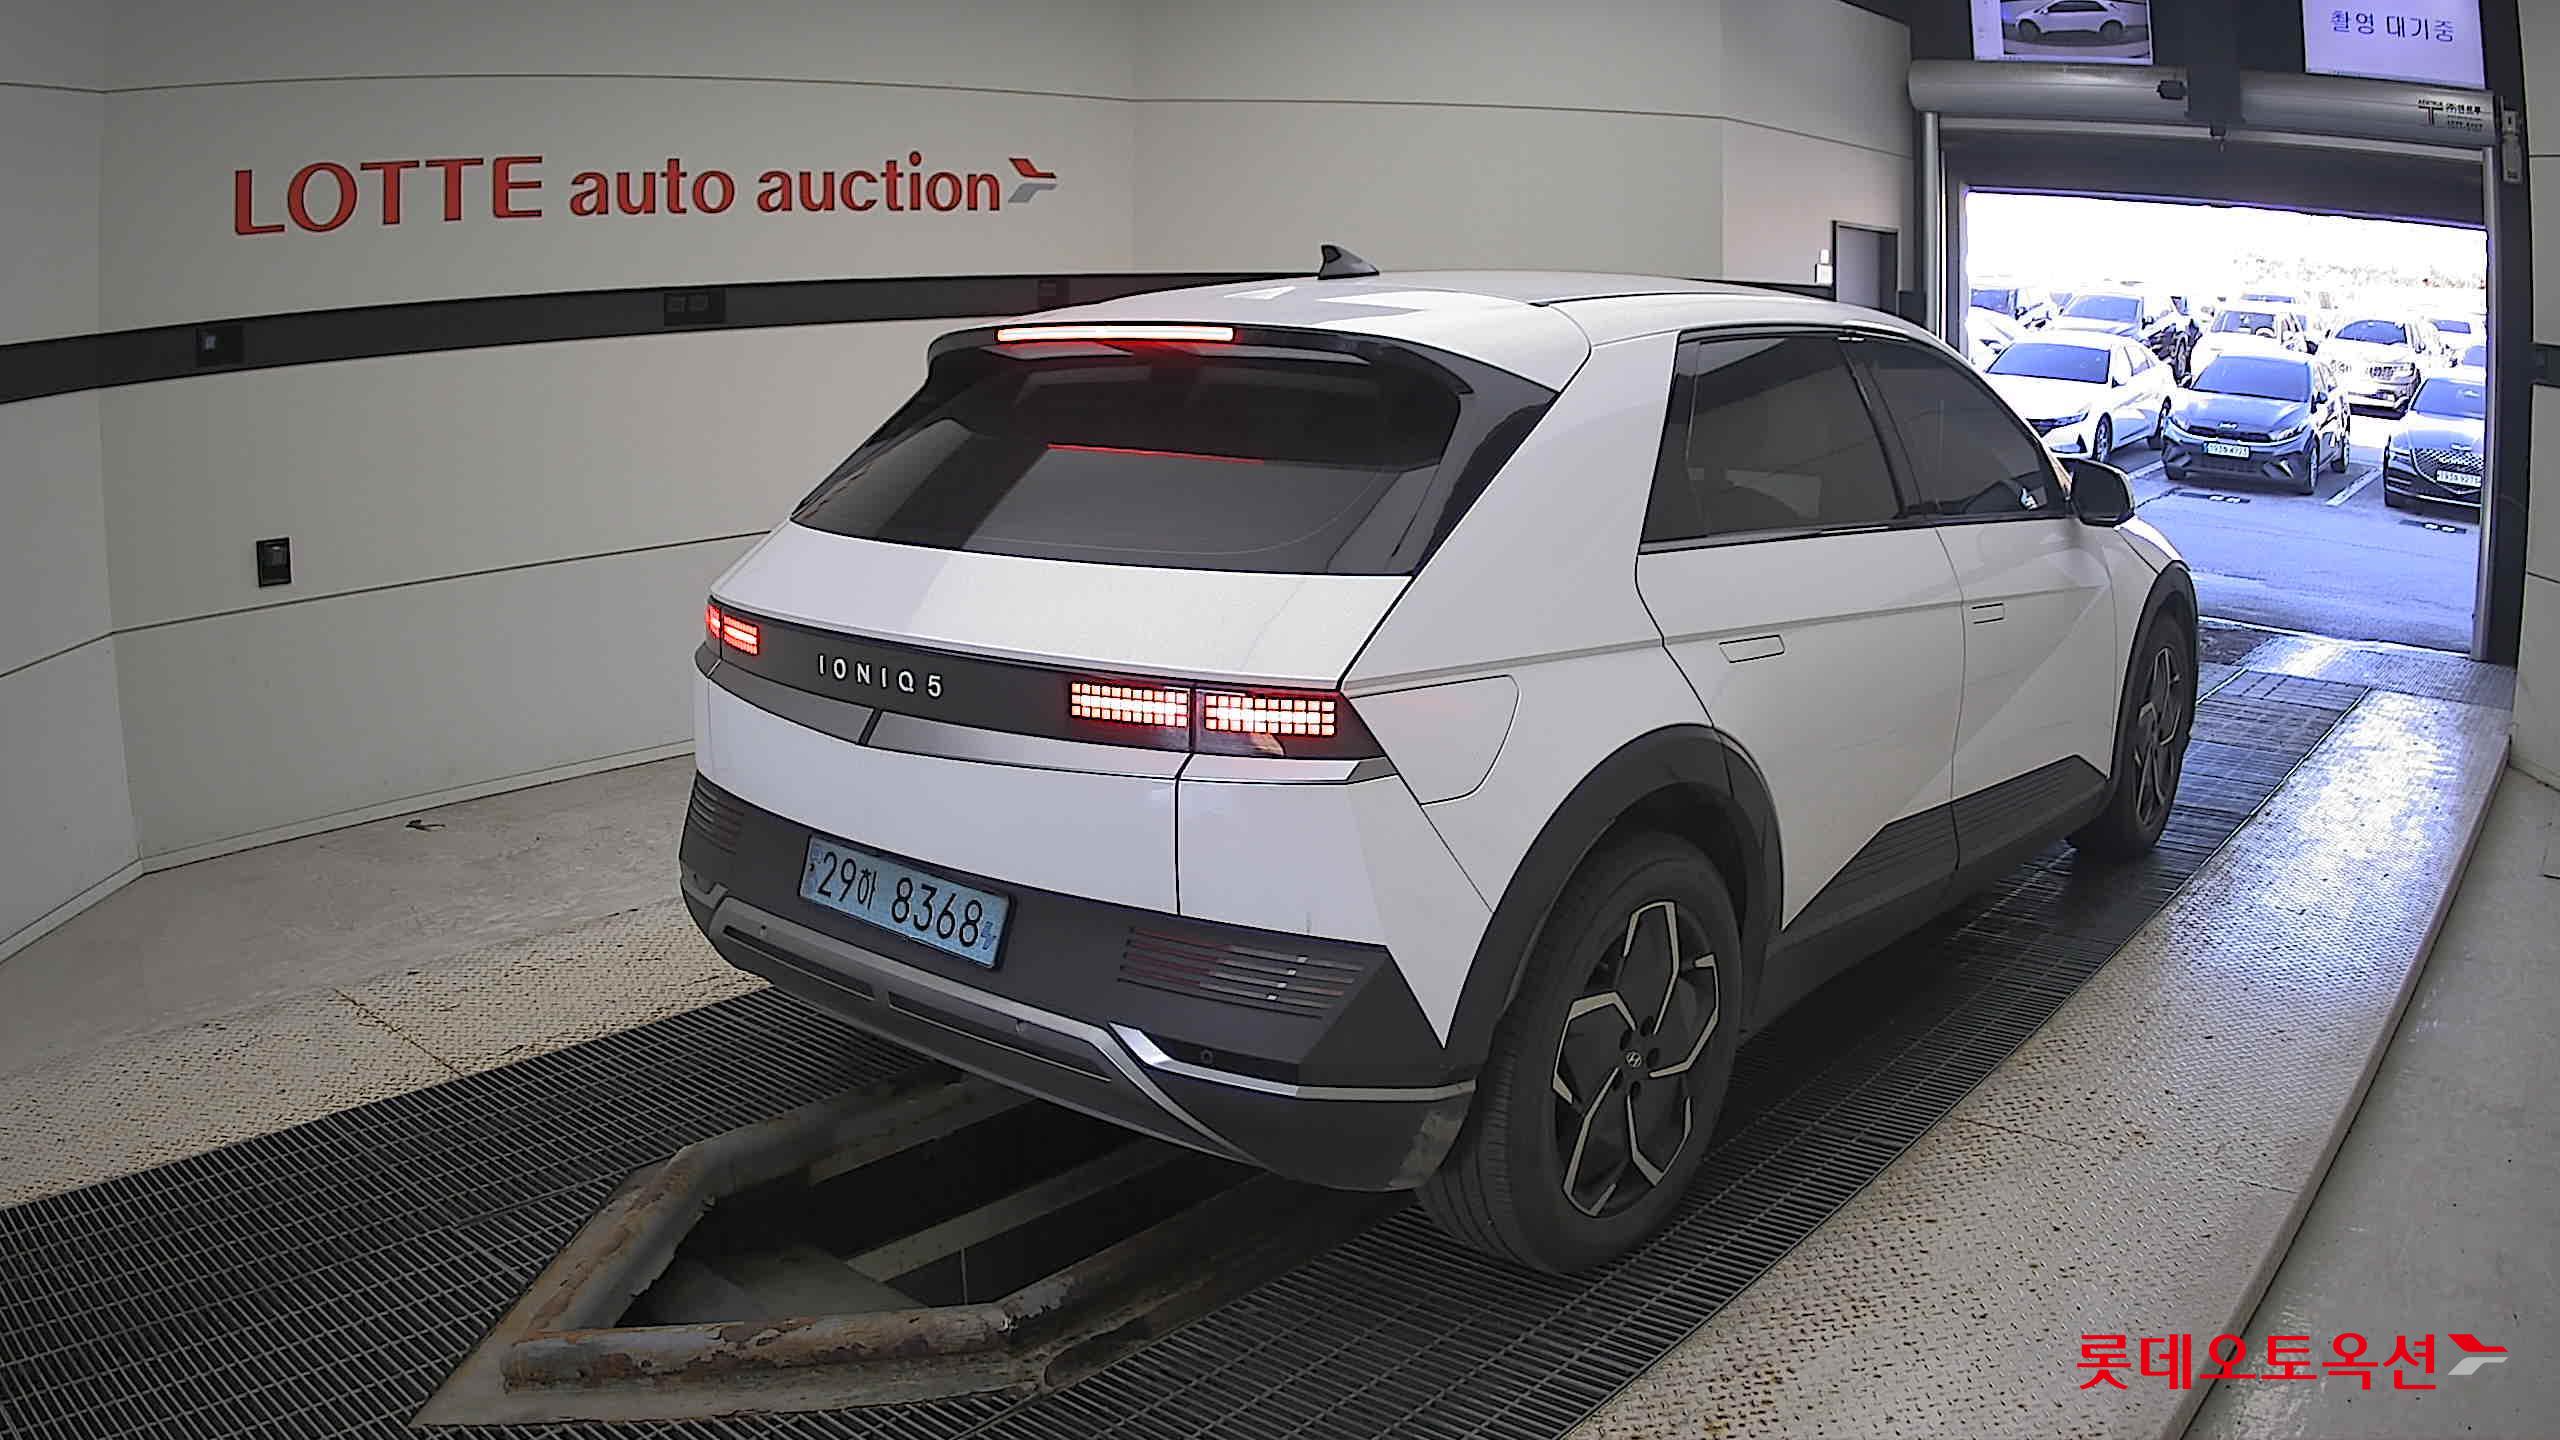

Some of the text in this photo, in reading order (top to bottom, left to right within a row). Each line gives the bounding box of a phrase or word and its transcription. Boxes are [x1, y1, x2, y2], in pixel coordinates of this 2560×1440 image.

[2331, 10, 2454, 43] 촬영 대기중
[234, 150, 1001, 236] LOTTE auto auction
[818, 654, 943, 698] IONIQ 5
[816, 851, 983, 948] 29하 8368
